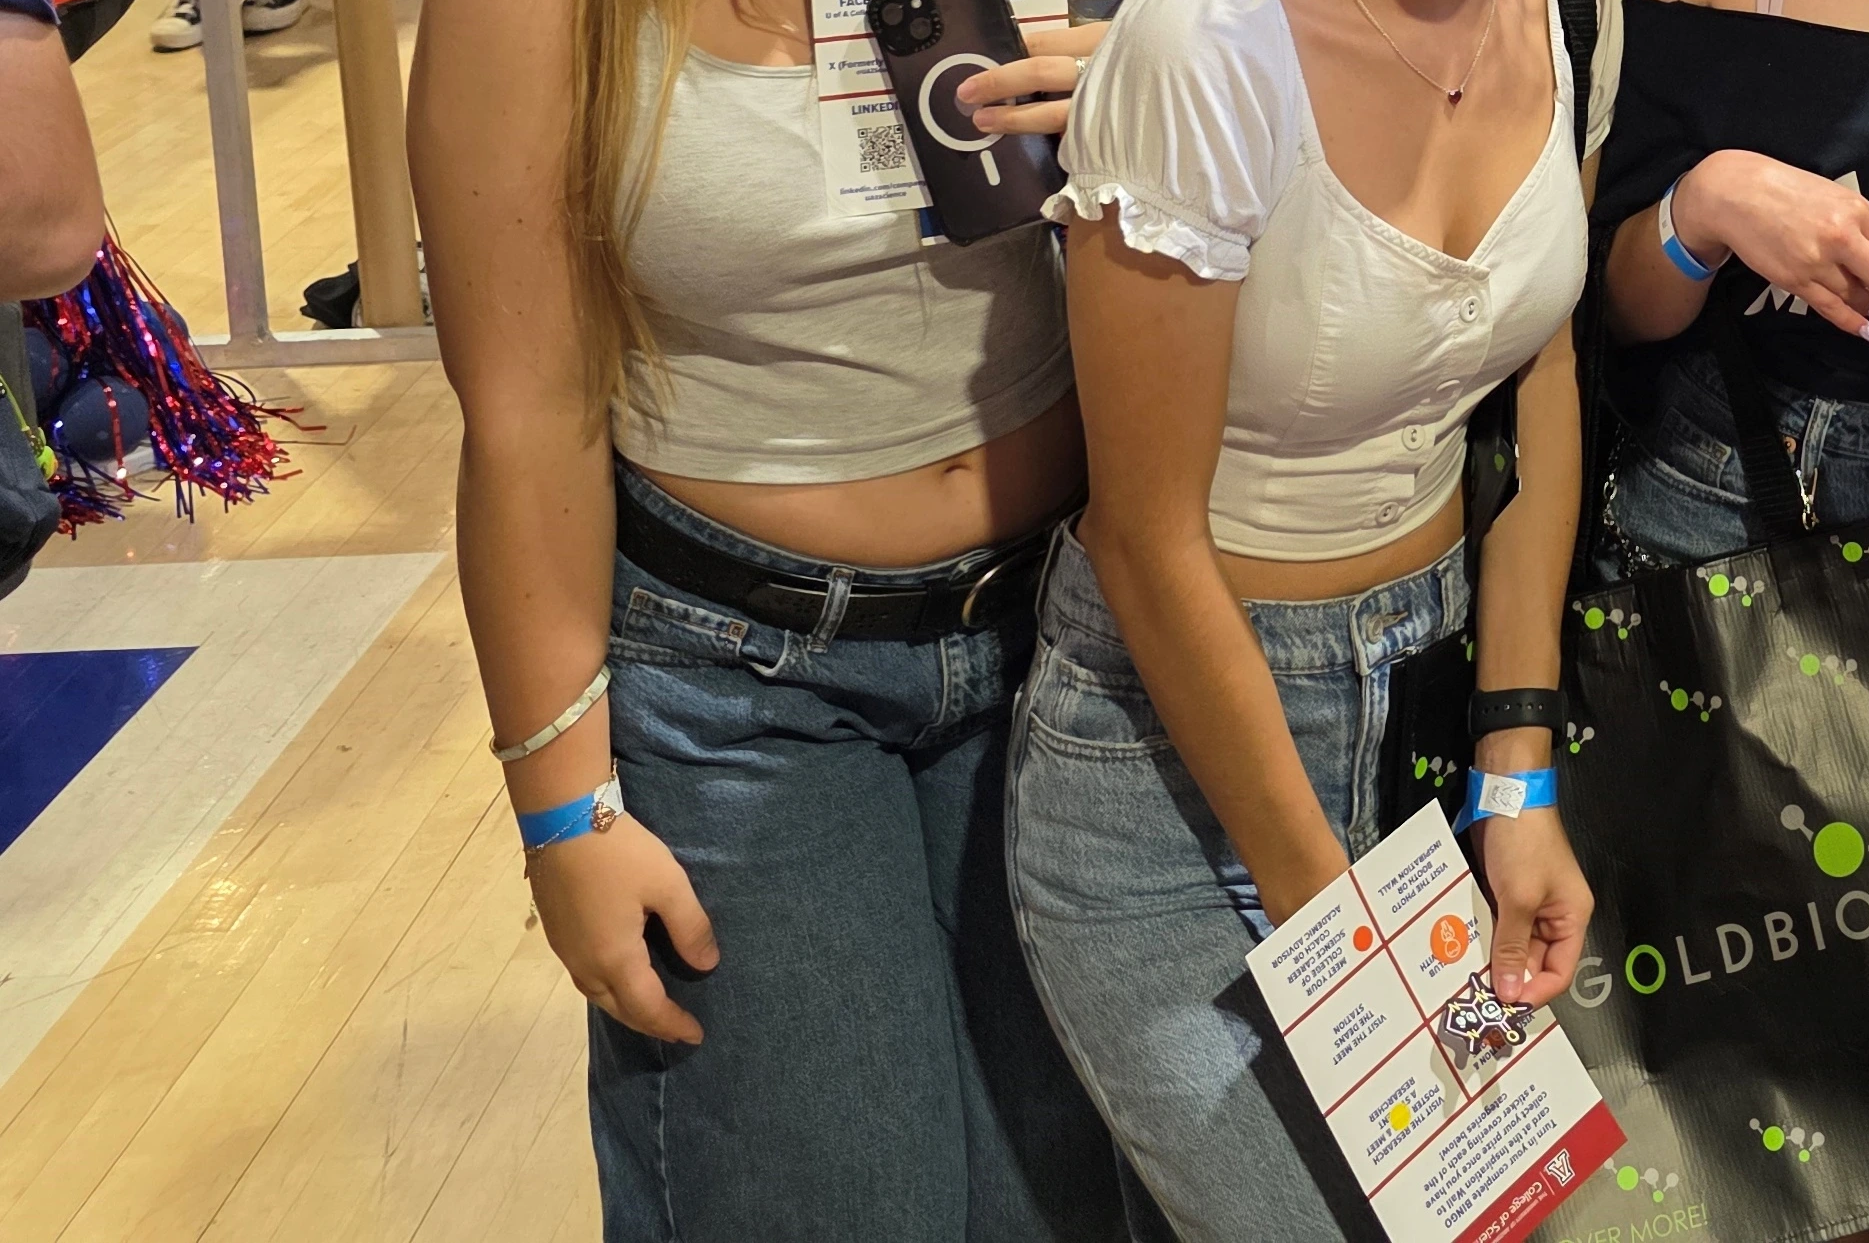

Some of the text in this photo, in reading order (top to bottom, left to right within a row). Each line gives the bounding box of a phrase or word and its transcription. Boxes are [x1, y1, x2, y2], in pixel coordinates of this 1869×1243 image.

[828, 62, 836, 71] X
[851, 100, 900, 115] LINKEDI
[1377, 840, 1442, 897] INSPIRATION WALL
[1391, 862, 1449, 914] VISIT THE PHOTO
[1397, 861, 1433, 895] BOOTH OR
[1271, 904, 1341, 969] ACADEMIC ADVISOR
[1287, 929, 1346, 984] SCIENCE CAREER
[1292, 929, 1330, 965] COACH OR
[1301, 946, 1343, 988] COLLEGE OF
[1305, 956, 1347, 997] MEET YOUR
[1333, 1003, 1365, 1035] STATION
[1334, 1010, 1375, 1049] THE DEANS
[1332, 1014, 1387, 1066] VISIT THE MEET
[1369, 1077, 1416, 1123] RESEARCHER
[1411, 1084, 1440, 1113] POSTER
[1502, 1089, 1530, 1118] sticker
[1366, 1134, 1387, 1157] MEET
[1372, 1096, 1446, 1165] VISIT THE RESEARCH
[1438, 1093, 1508, 1162] categories below!
[1466, 1115, 1502, 1150] covering
[1425, 1091, 1547, 1209] collect your prize once you have
[1436, 1106, 1550, 1216] card at the Inspiration Wall to
[1447, 1148, 1468, 1169] each
[1544, 1148, 1575, 1187] A
[1423, 1176, 1439, 1192] the
[1438, 1166, 1448, 1181] of
[1444, 1119, 1558, 1229] Turn in your complete BINGO
[1480, 1181, 1543, 1241] College of Scie
[1630, 1203, 1709, 1243] MORE!
